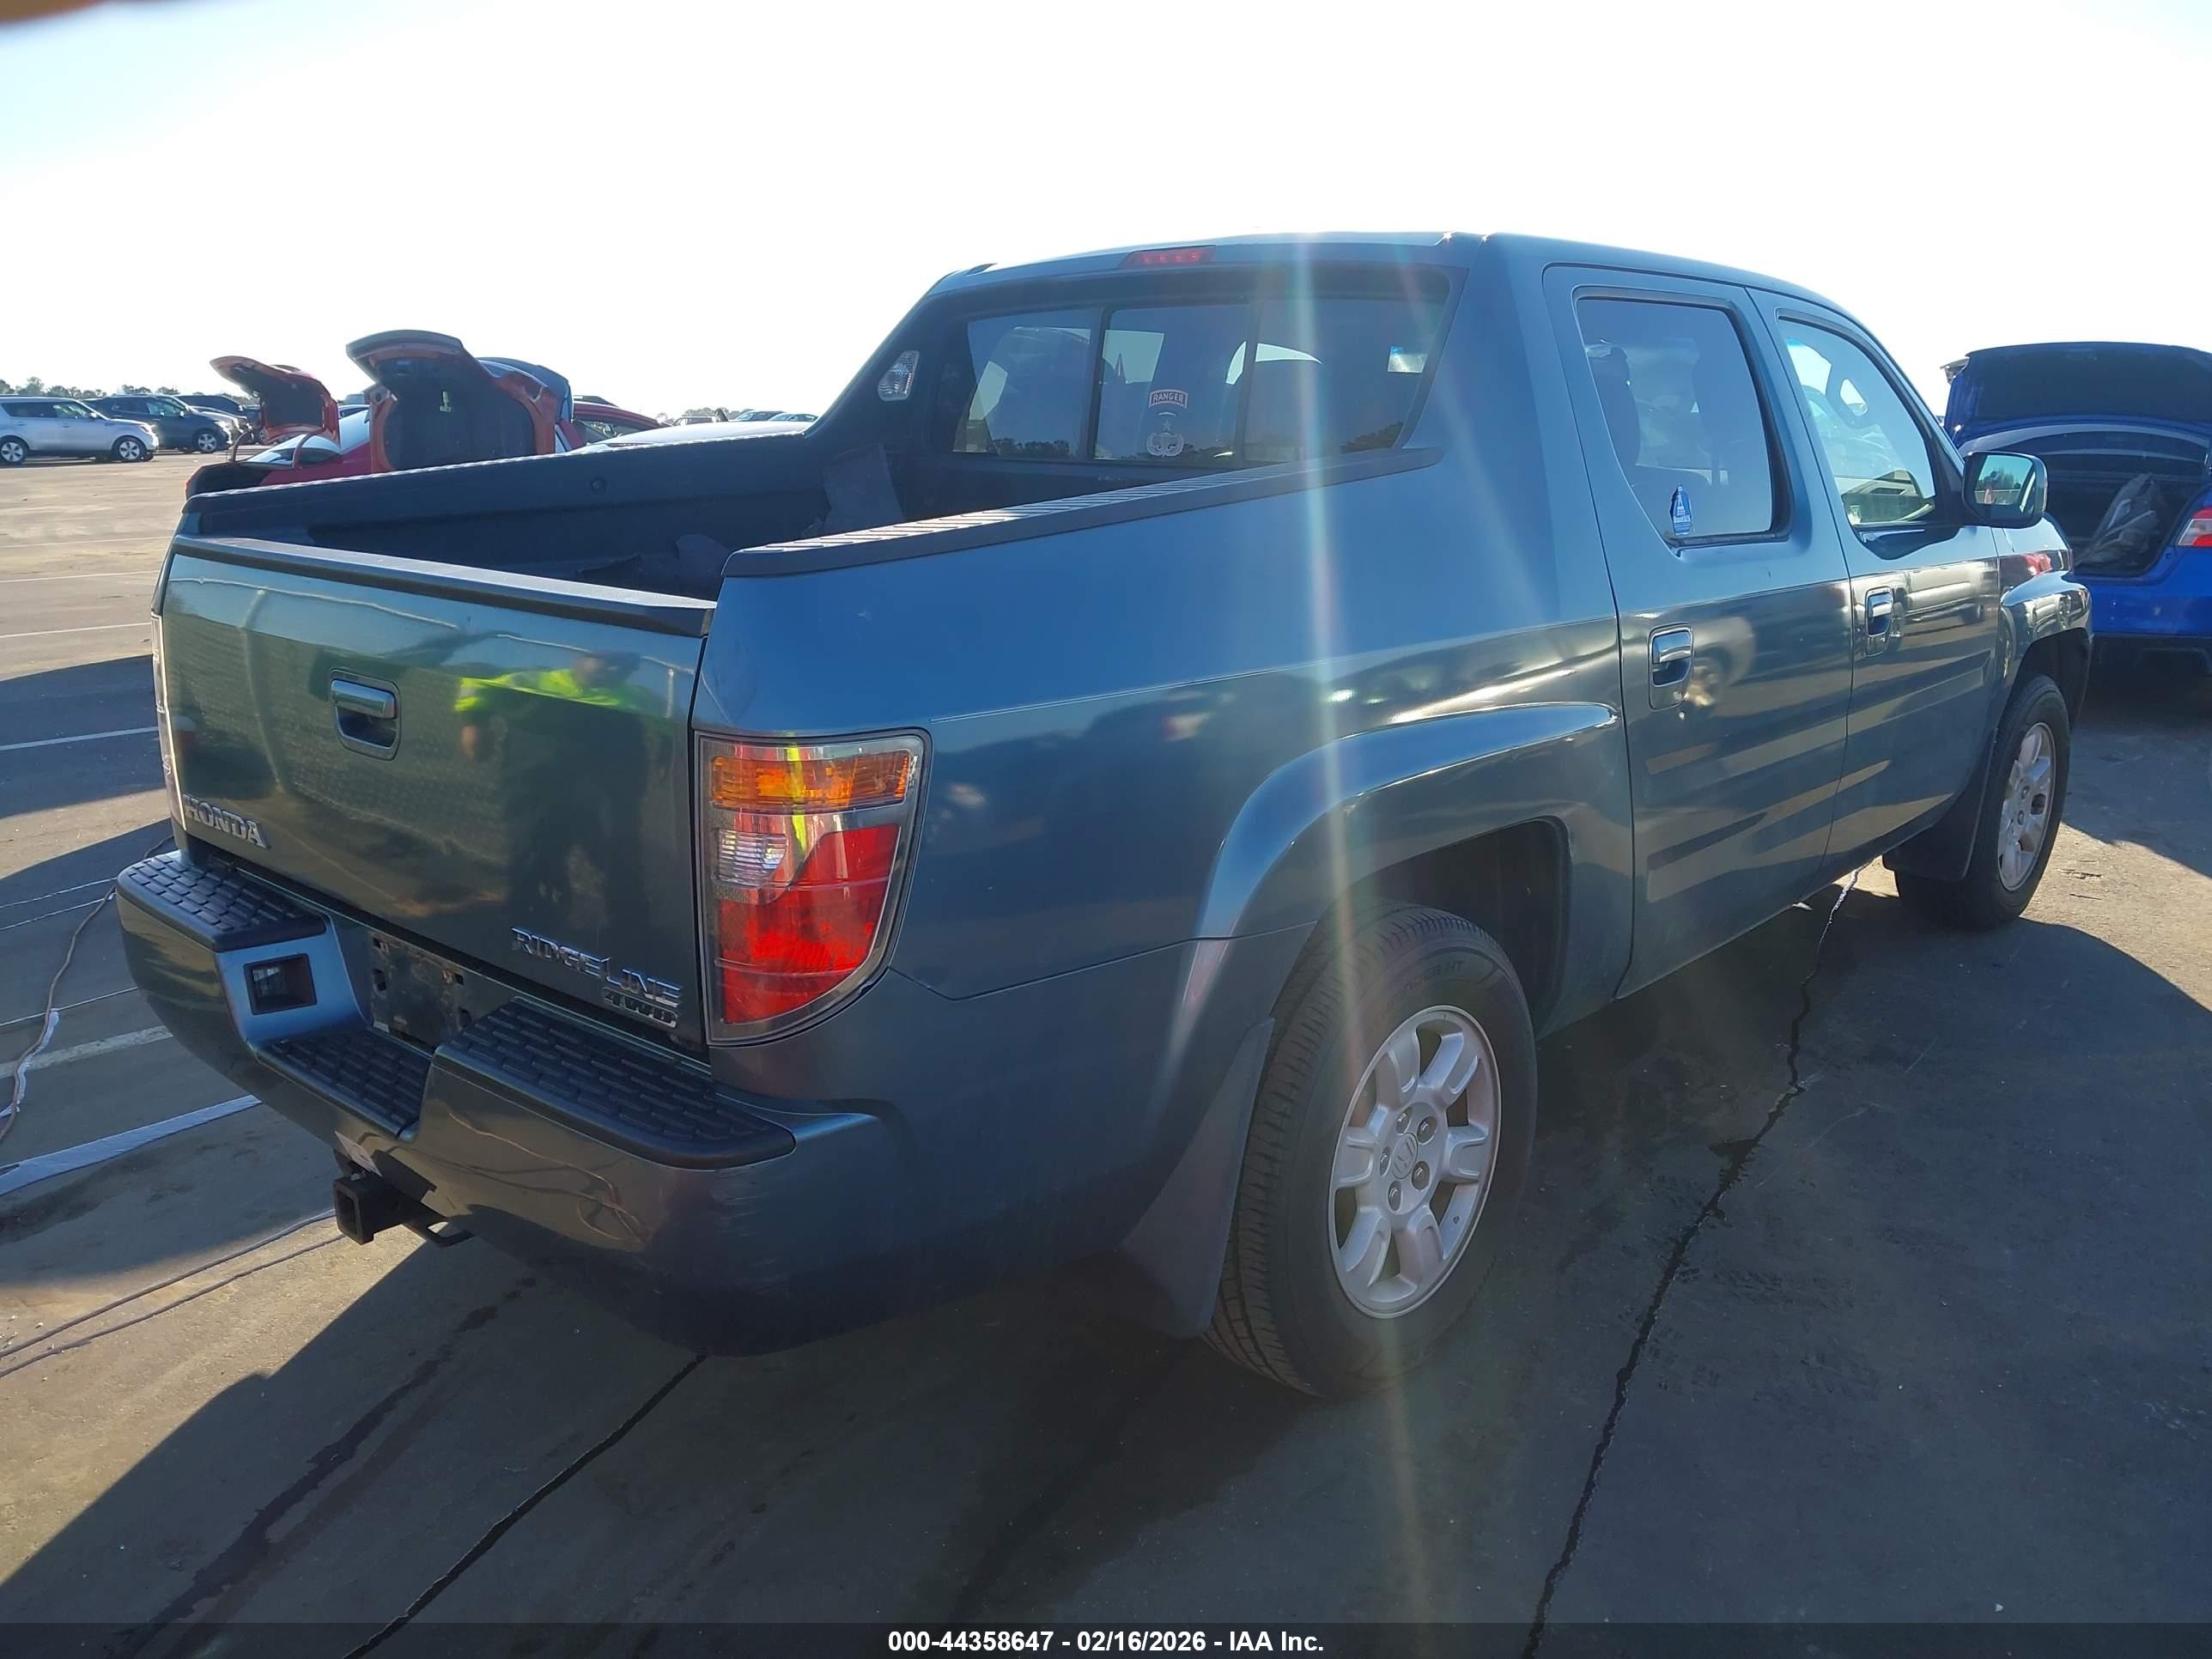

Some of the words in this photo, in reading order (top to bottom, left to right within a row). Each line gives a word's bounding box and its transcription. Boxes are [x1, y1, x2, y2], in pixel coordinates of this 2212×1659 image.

[1152, 392, 1184, 404] RANGER
[182, 794, 267, 848] HONDA
[511, 927, 682, 1008] RIDGELINE
[602, 987, 678, 1029] 4WD
